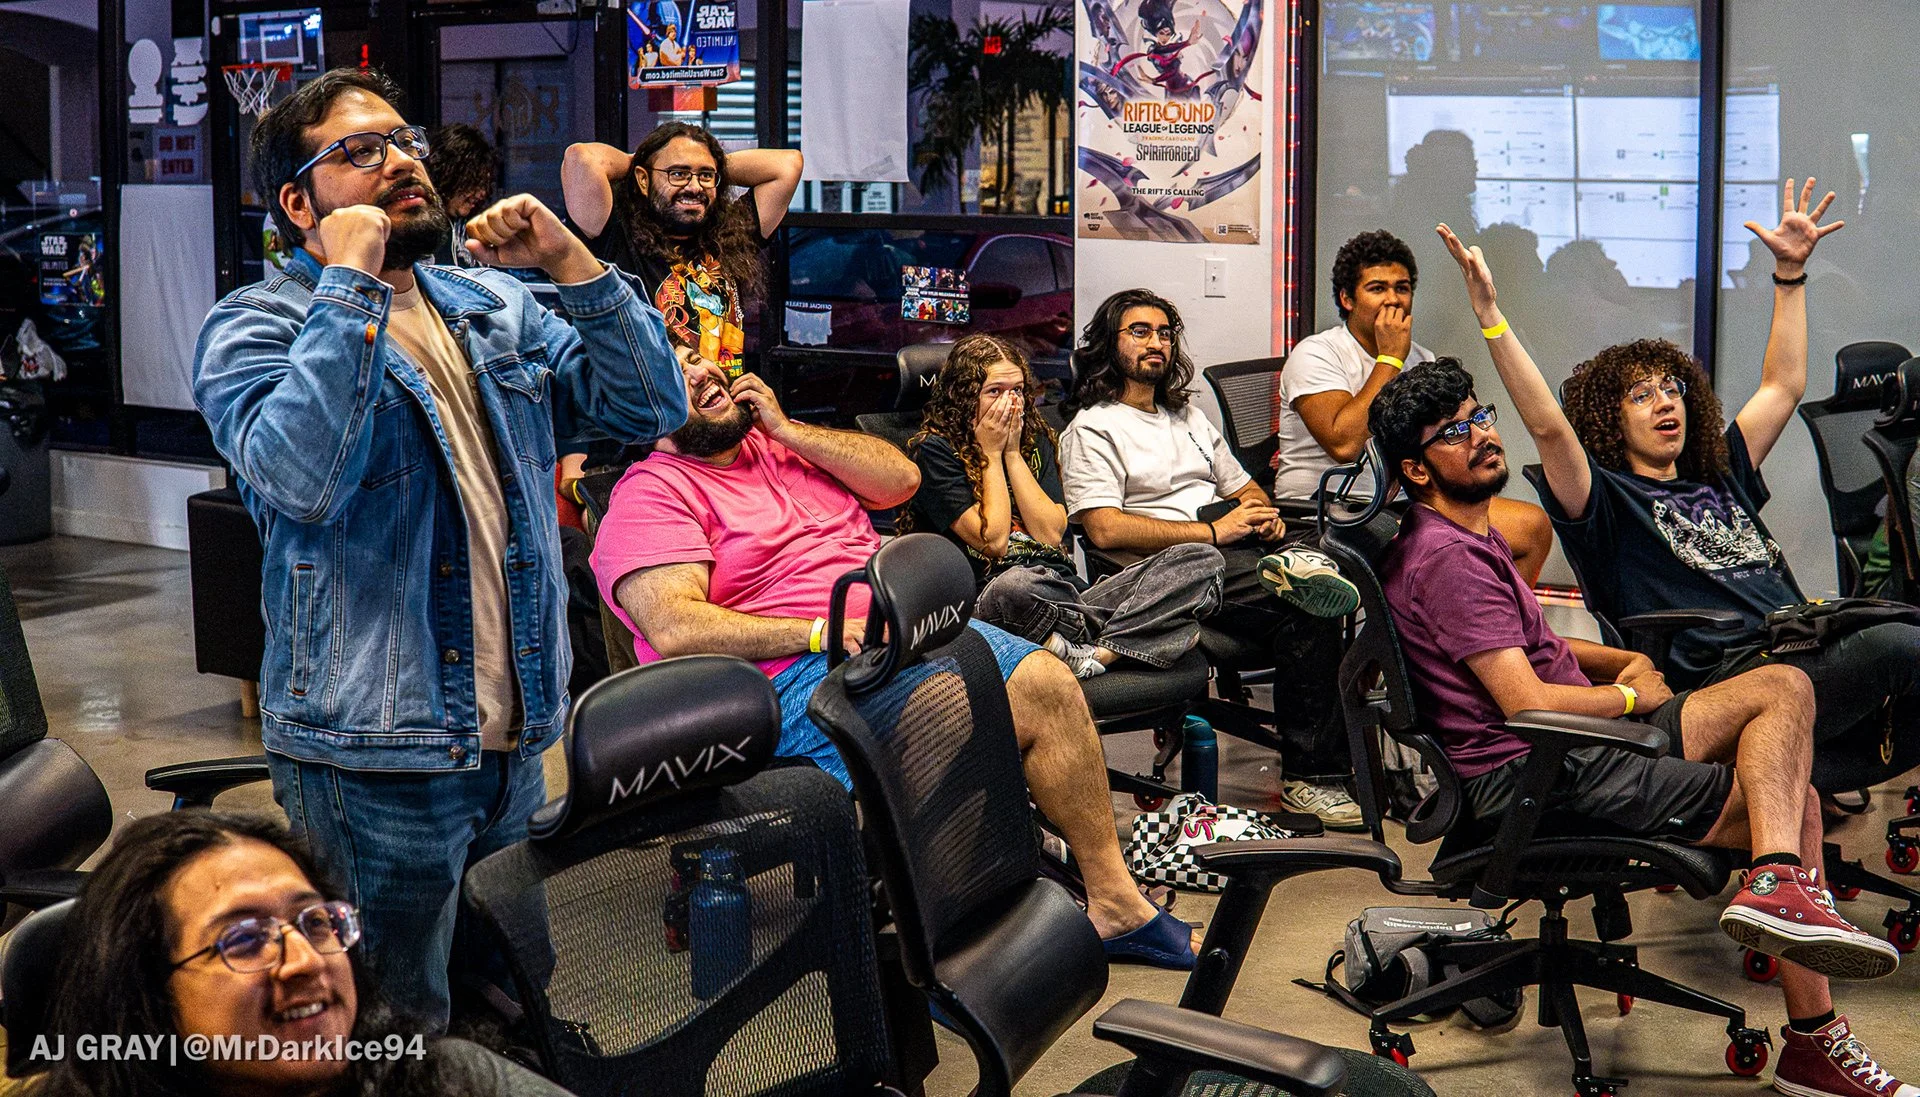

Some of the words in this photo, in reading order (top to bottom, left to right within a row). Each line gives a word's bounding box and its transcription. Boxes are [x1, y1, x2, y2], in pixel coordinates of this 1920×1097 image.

[1123, 101, 1216, 124] RIFTBOUND
[1123, 124, 1162, 134] LEAGUE
[1168, 124, 1215, 134] LEGENDS
[1147, 188, 1164, 196] RIFT
[1173, 189, 1205, 197] CALLING
[1852, 372, 1896, 389] MAV
[910, 600, 965, 650] MAVIX
[608, 735, 752, 805] MAVIX
